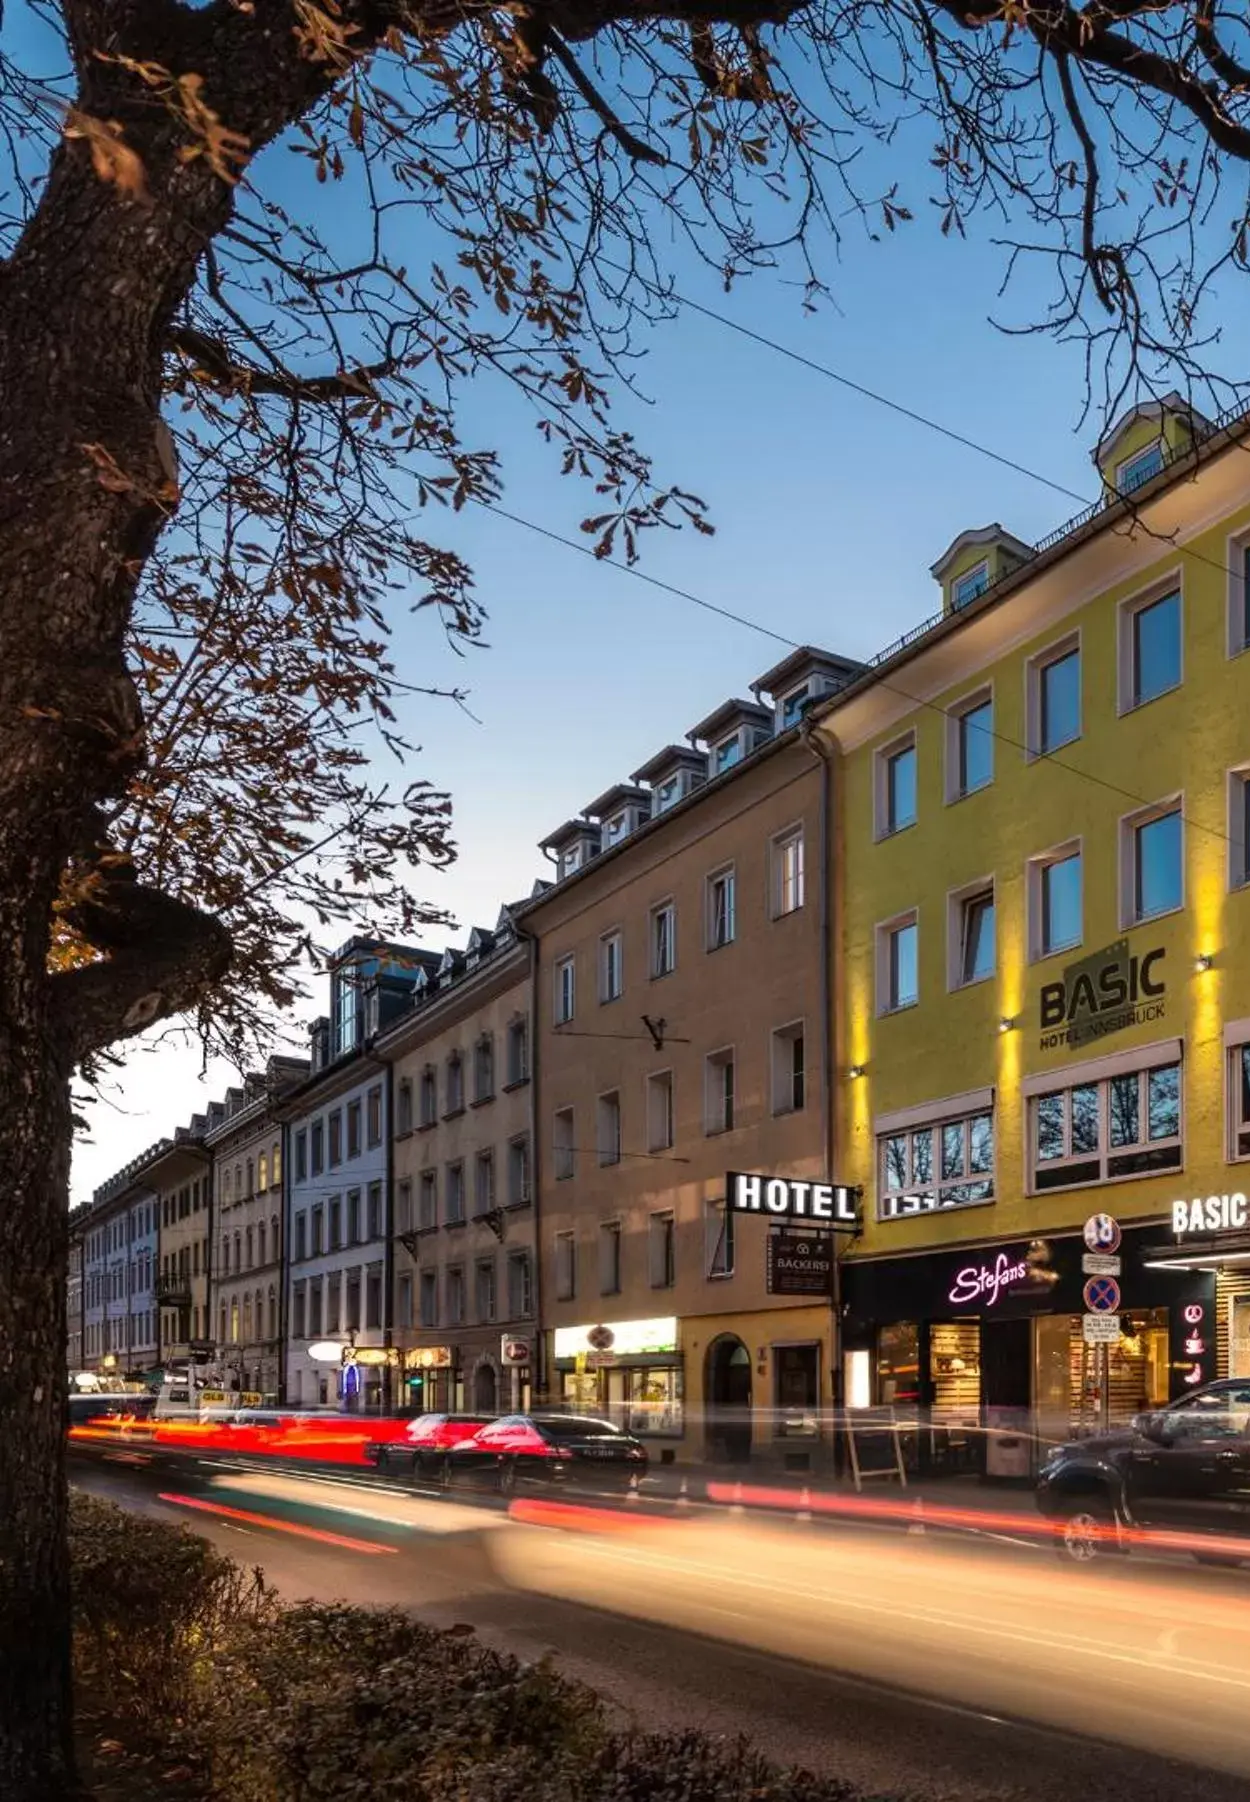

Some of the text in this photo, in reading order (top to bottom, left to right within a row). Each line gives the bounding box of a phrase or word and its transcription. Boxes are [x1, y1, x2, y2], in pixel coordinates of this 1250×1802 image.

[1040, 947, 1165, 1029] BASIC
[1040, 1028, 1080, 1051] HOTEL
[737, 1175, 856, 1219] HOTEL
[1172, 1192, 1247, 1233] BASIC
[949, 1253, 1026, 1305] Stefans
